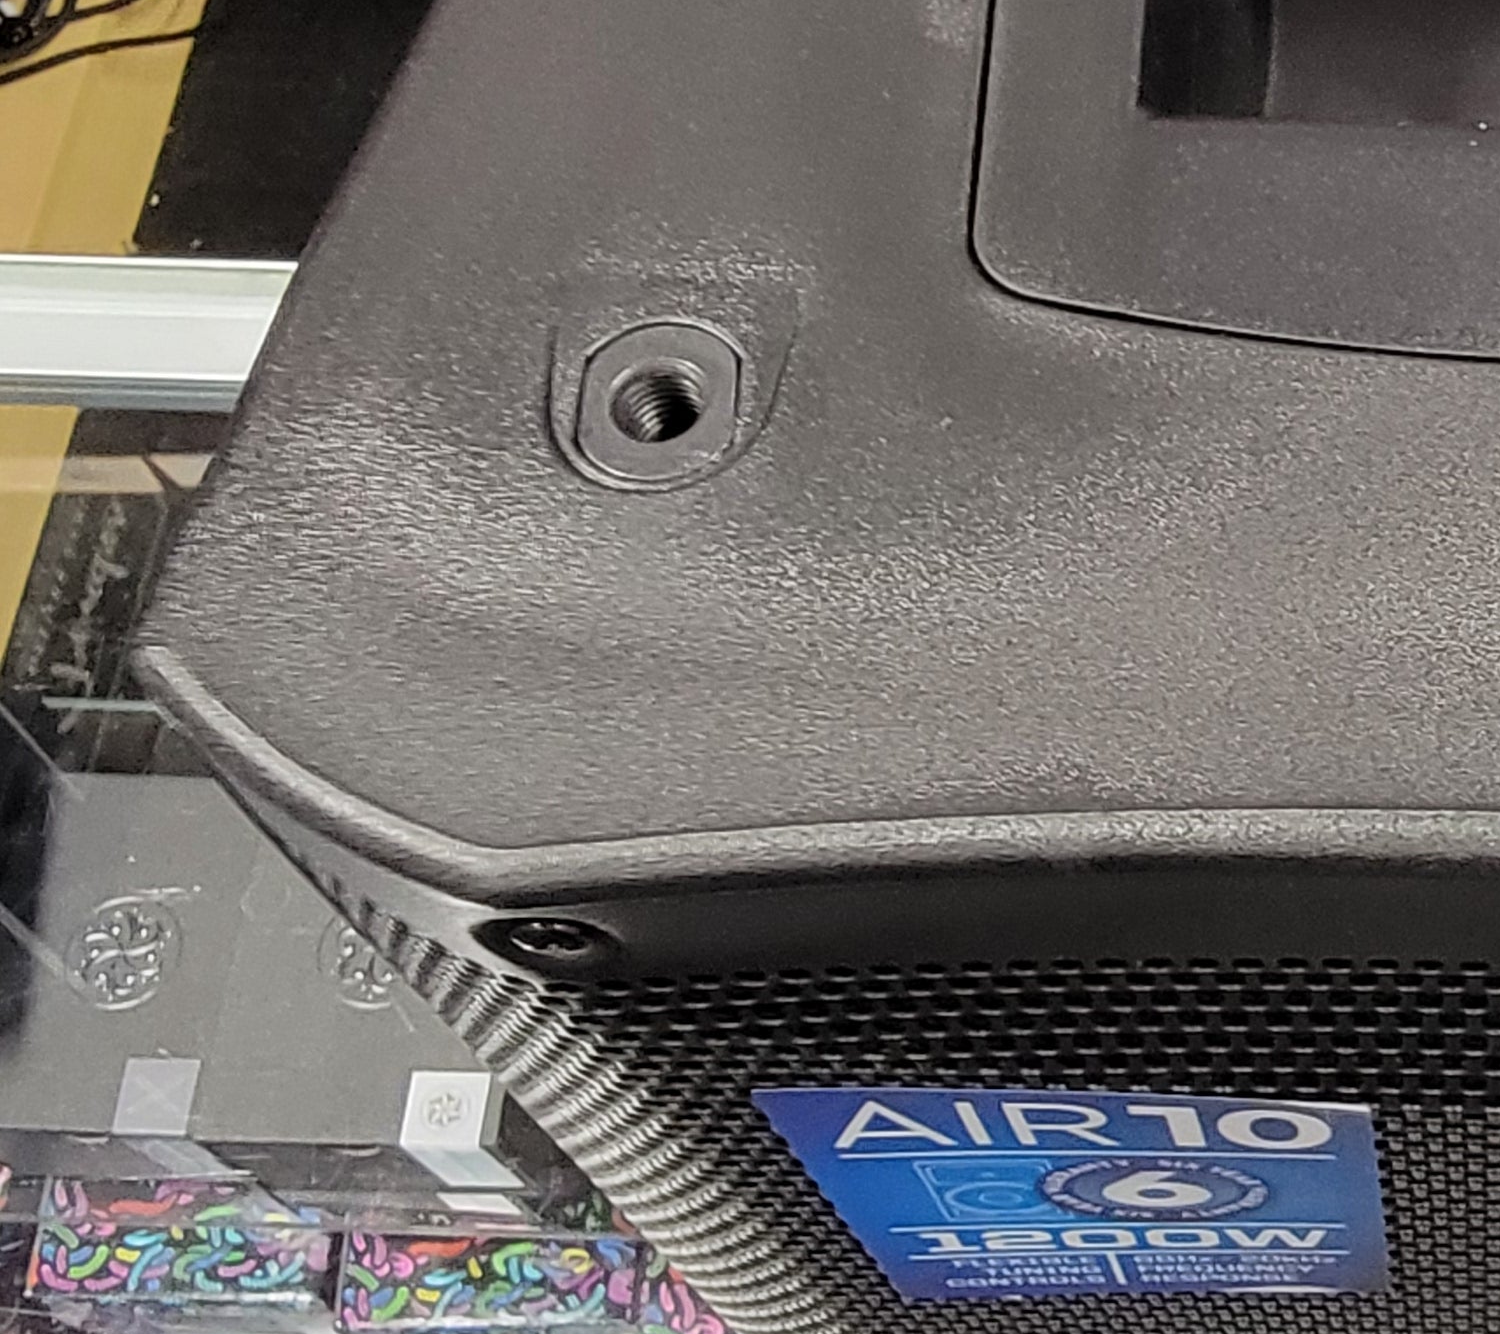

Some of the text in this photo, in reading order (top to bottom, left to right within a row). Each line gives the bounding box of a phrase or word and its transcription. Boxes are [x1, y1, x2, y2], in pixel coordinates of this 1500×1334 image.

[832, 1098, 1333, 1151] AIR10
[1102, 1170, 1213, 1208] 6
[919, 1228, 1328, 1253] 1200W
[952, 1256, 1097, 1267] FLEXIBLE
[985, 1266, 1103, 1277] TUNING
[1138, 1263, 1315, 1274] FREQUENCY
[946, 1275, 1106, 1288] CONTROLS
[1140, 1273, 1299, 1283] RESPONSE
